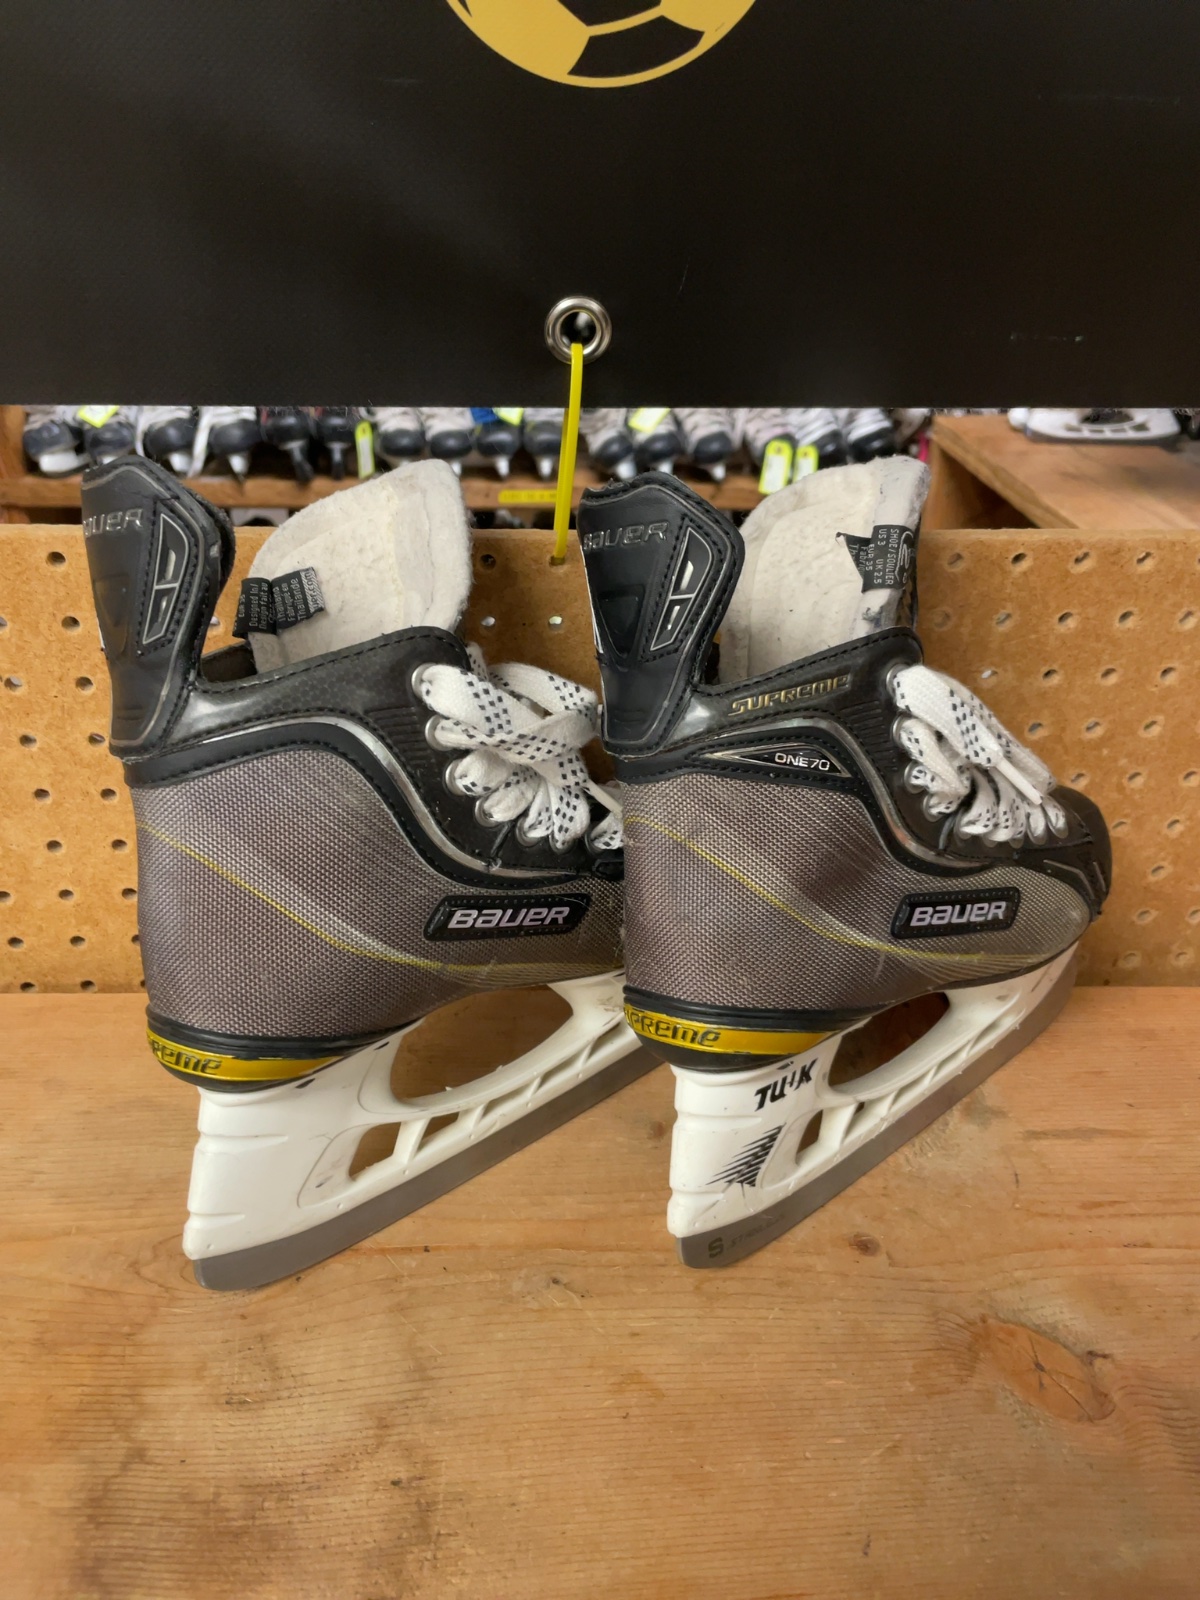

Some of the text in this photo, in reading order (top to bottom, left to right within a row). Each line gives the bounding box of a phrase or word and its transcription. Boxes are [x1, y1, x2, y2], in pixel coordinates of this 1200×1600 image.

[878, 528, 888, 539] US
[865, 543, 875, 571] EUR 35
[875, 558, 884, 570] UK
[873, 571, 883, 584] 2.5
[774, 752, 830, 771] ONE70
[447, 906, 570, 929] BAUER
[909, 901, 1006, 927] BAUER
